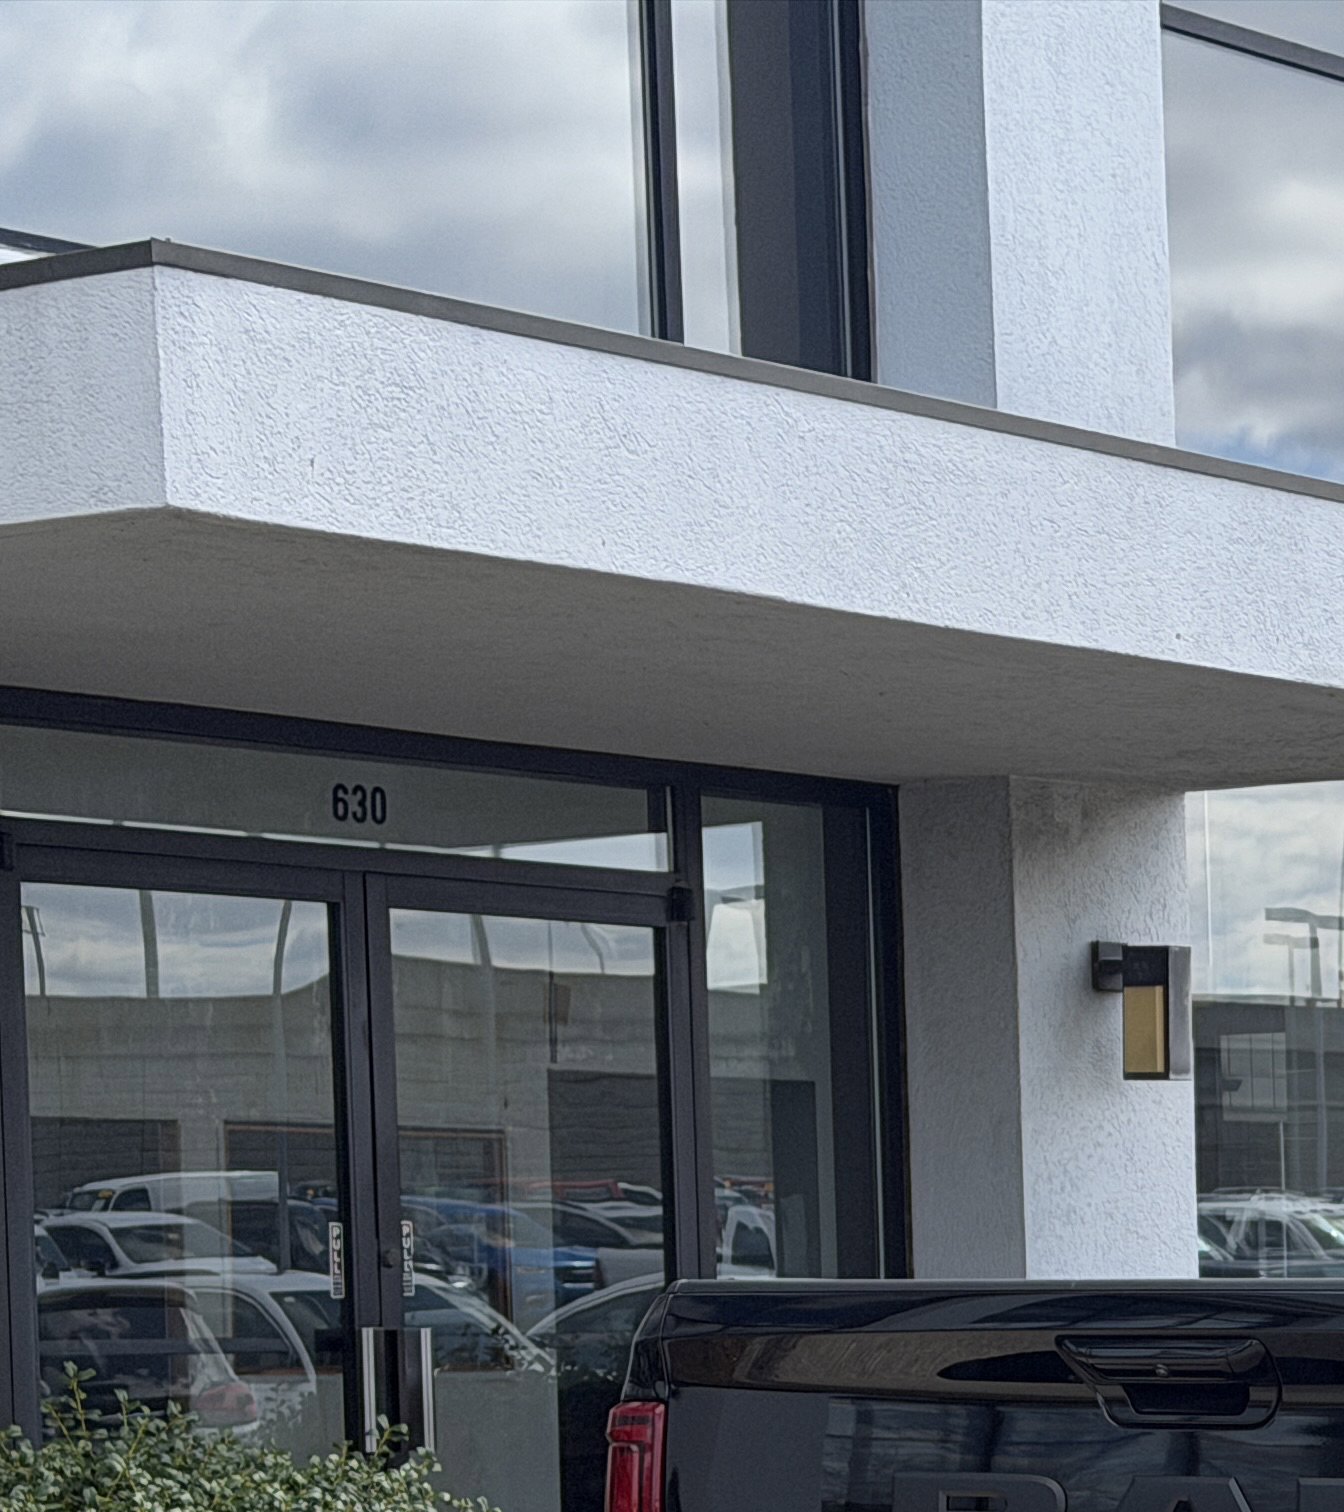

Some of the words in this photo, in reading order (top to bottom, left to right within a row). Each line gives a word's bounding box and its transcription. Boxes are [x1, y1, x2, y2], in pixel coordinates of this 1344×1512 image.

[332, 783, 387, 825] 630
[332, 1226, 341, 1274] PULL
[402, 1225, 411, 1272] PULL
